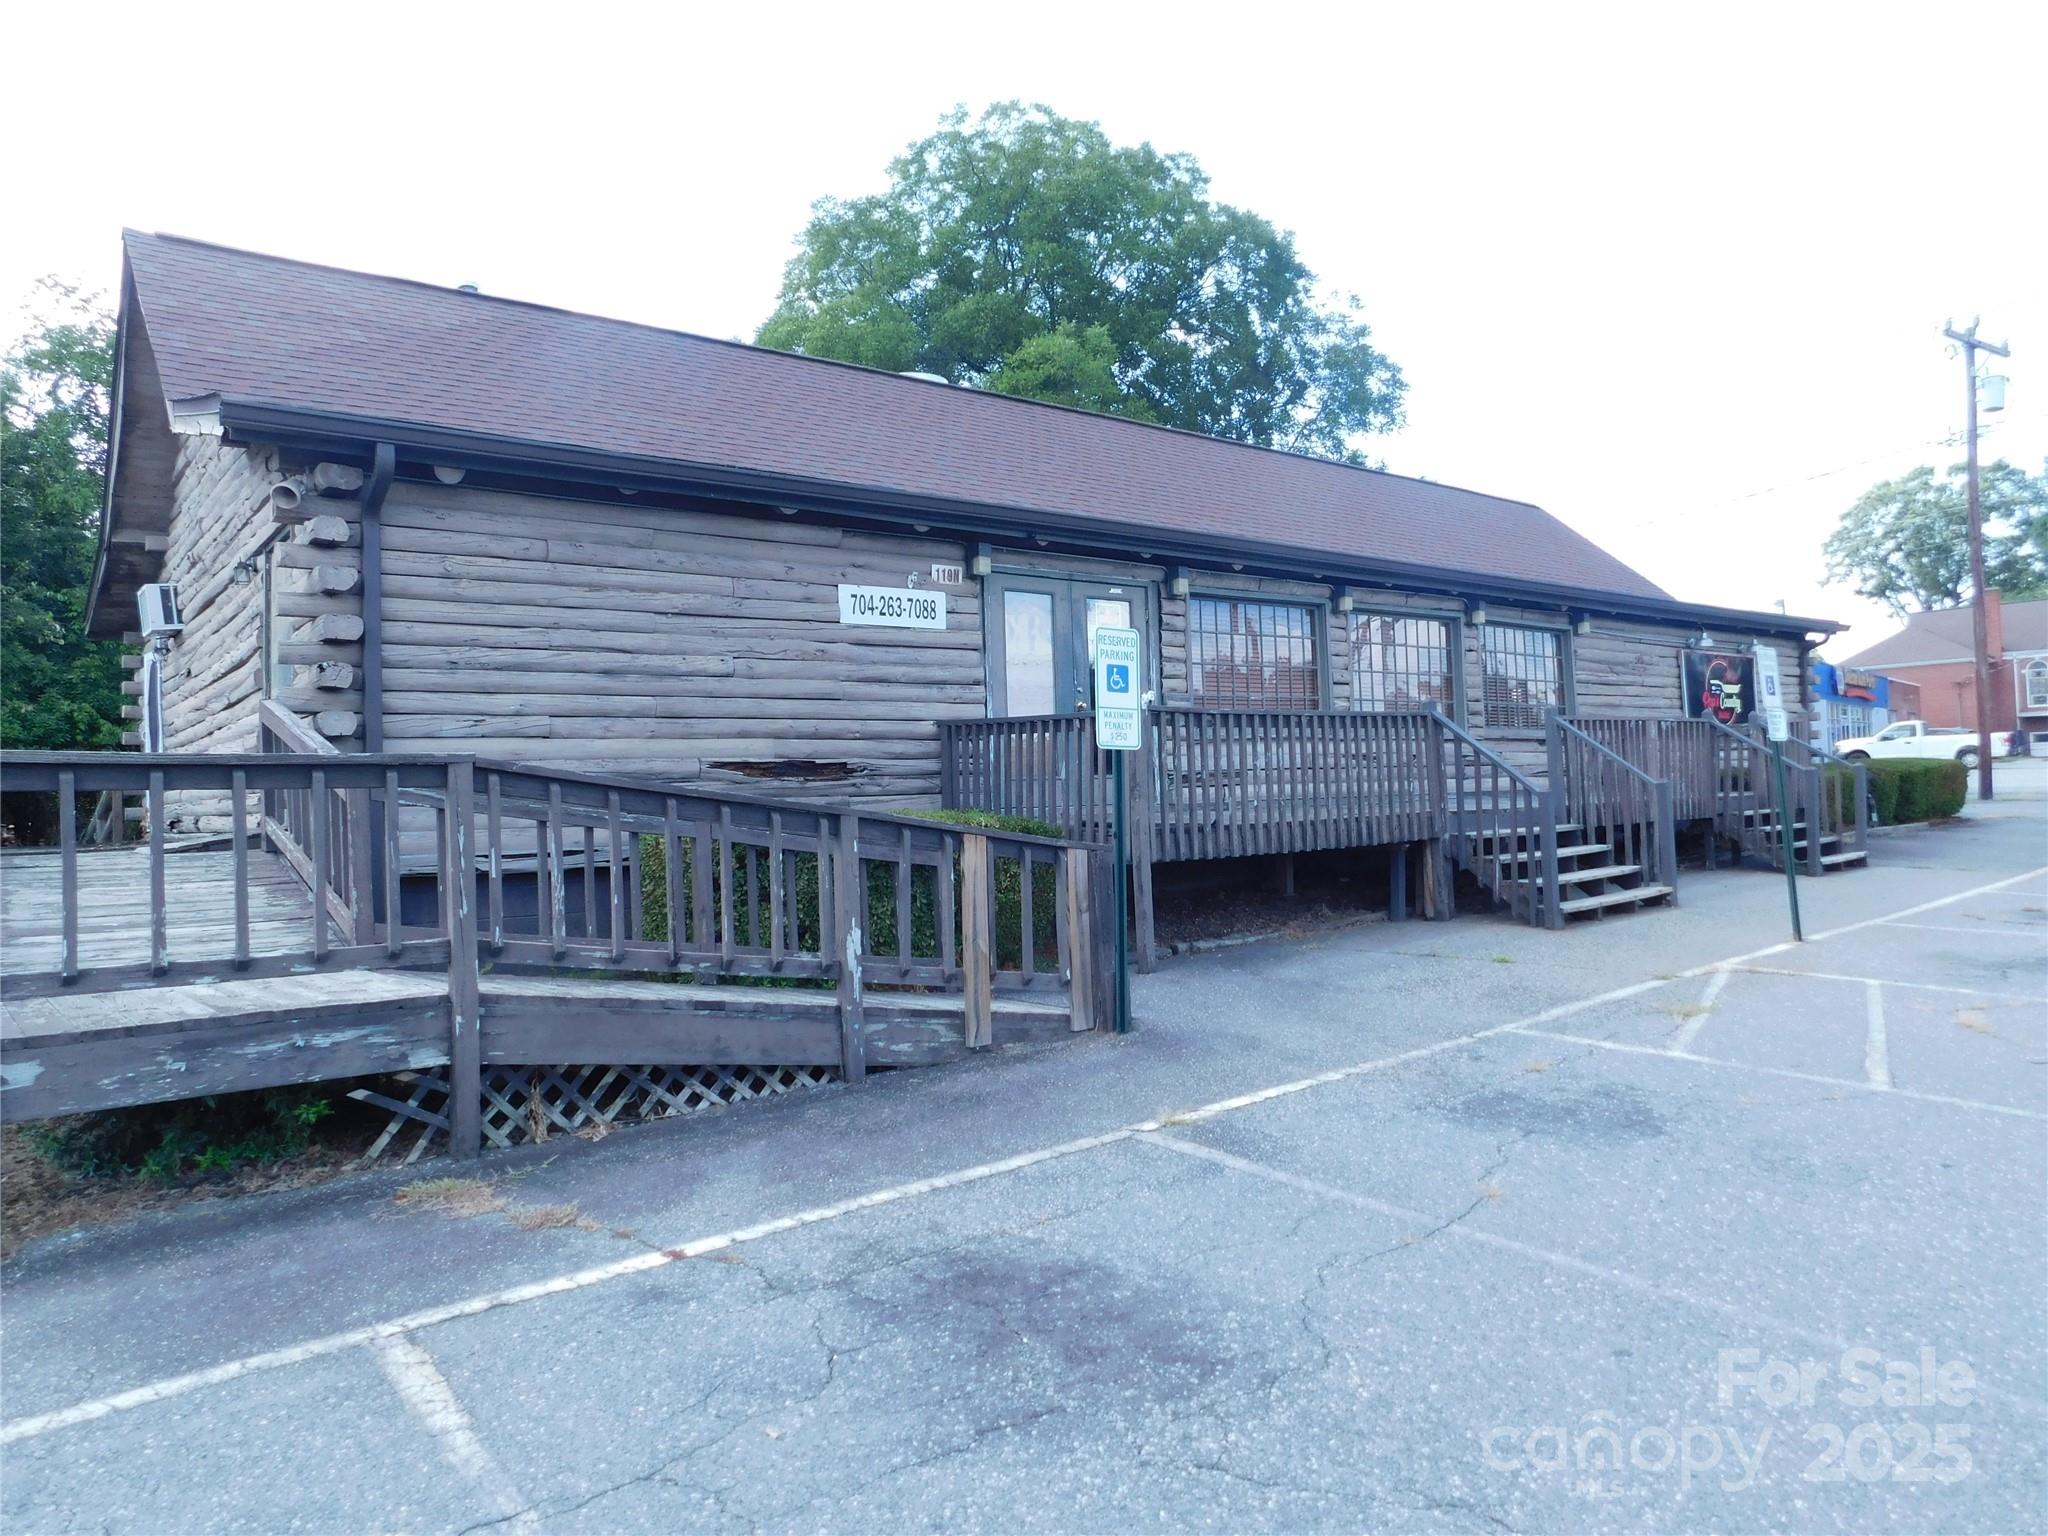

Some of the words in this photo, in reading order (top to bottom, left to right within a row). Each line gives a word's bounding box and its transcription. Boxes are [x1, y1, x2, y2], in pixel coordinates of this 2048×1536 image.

[935, 567, 960, 584] 119N
[850, 594, 937, 620] 704-263-7088
[1098, 634, 1136, 648] RESERVED
[1100, 648, 1135, 662] PARKING
[1103, 711, 1134, 721] MAXIMUM
[1104, 721, 1132, 731] PENALTY
